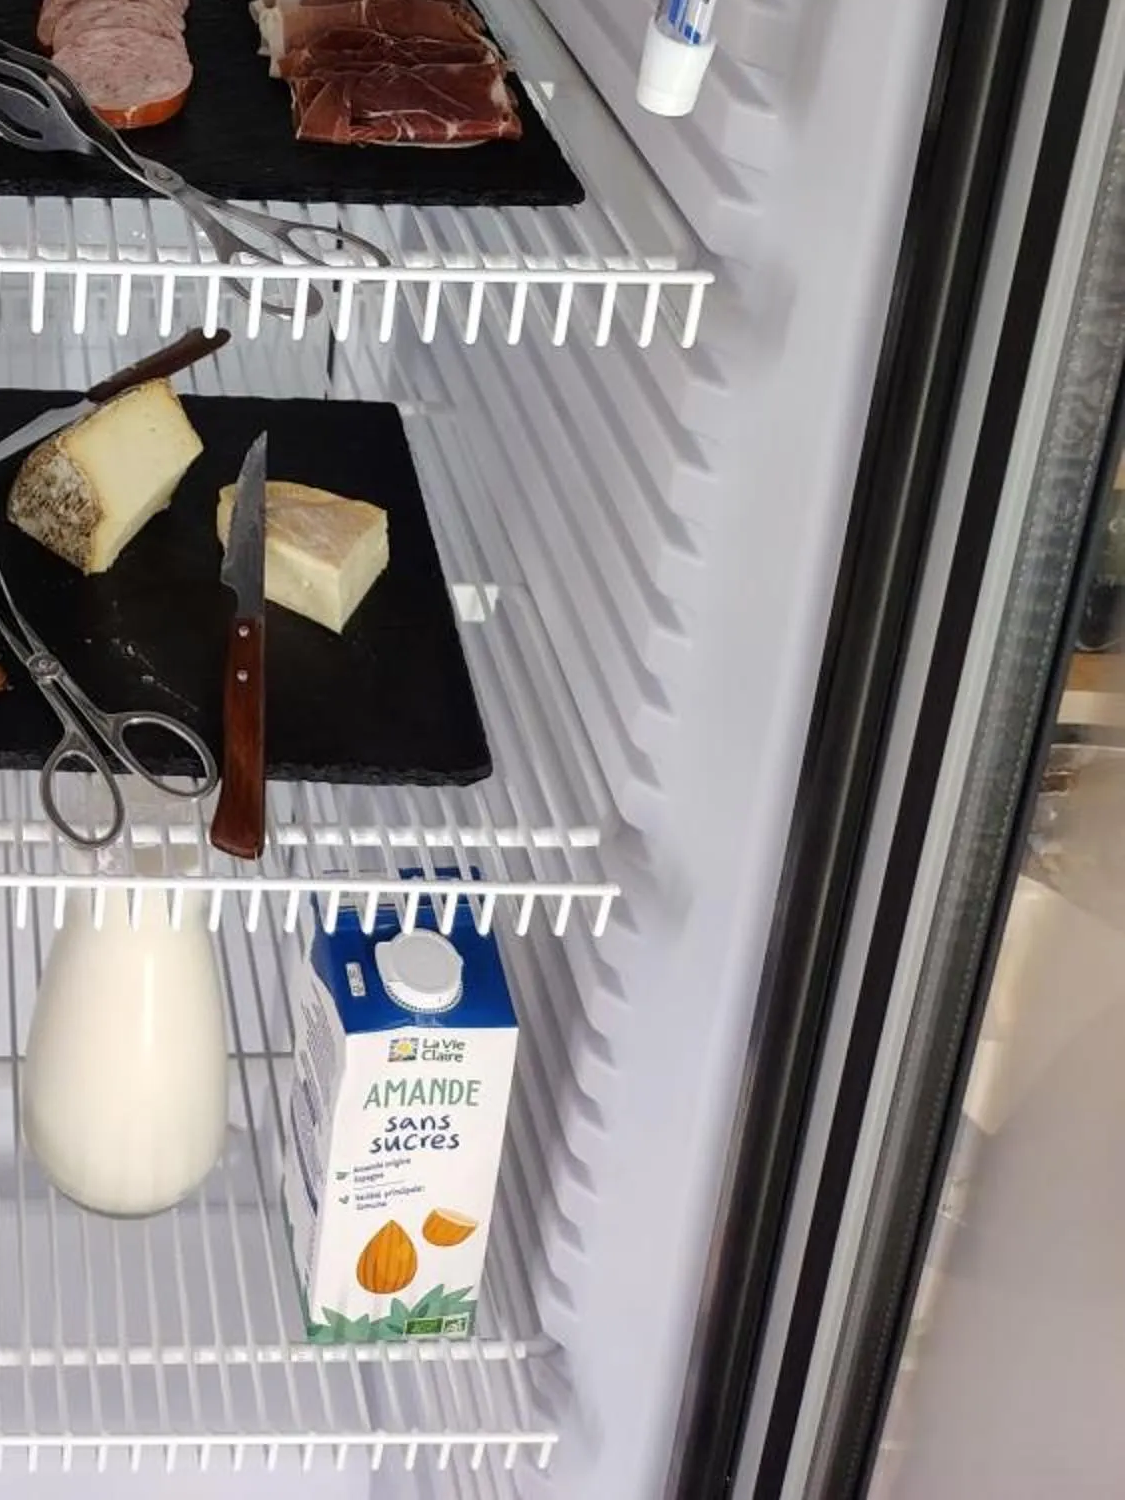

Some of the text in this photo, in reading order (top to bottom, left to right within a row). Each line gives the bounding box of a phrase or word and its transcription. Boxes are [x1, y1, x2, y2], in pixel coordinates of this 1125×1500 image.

[422, 1037, 466, 1051] La Vie
[421, 1049, 464, 1063] Claire
[362, 1076, 482, 1111] AMANDE
[384, 1113, 451, 1133] sans
[368, 1133, 460, 1154] sucres
